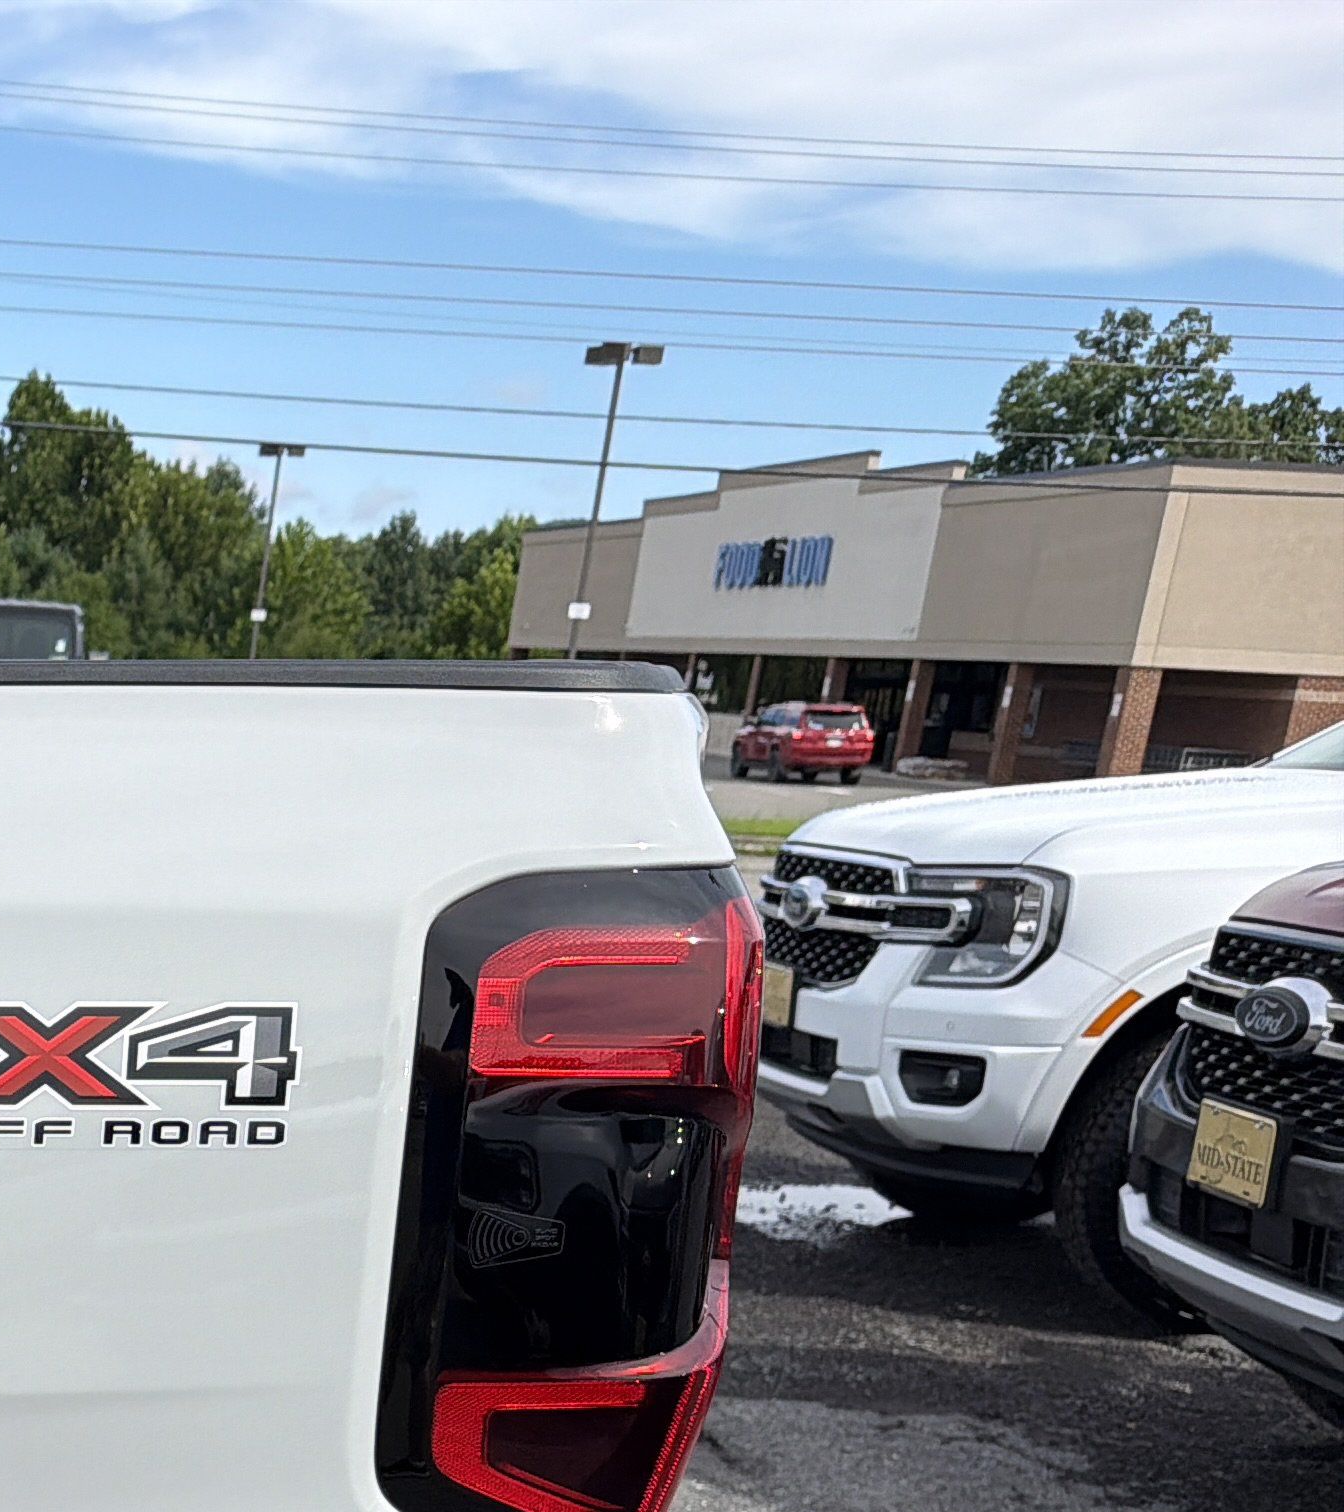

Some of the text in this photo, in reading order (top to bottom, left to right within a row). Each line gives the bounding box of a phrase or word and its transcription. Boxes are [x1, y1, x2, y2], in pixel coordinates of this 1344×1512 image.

[713, 535, 834, 592] FOOD LION
[1244, 997, 1287, 1035] Ford
[100, 1117, 289, 1148] ROAD
